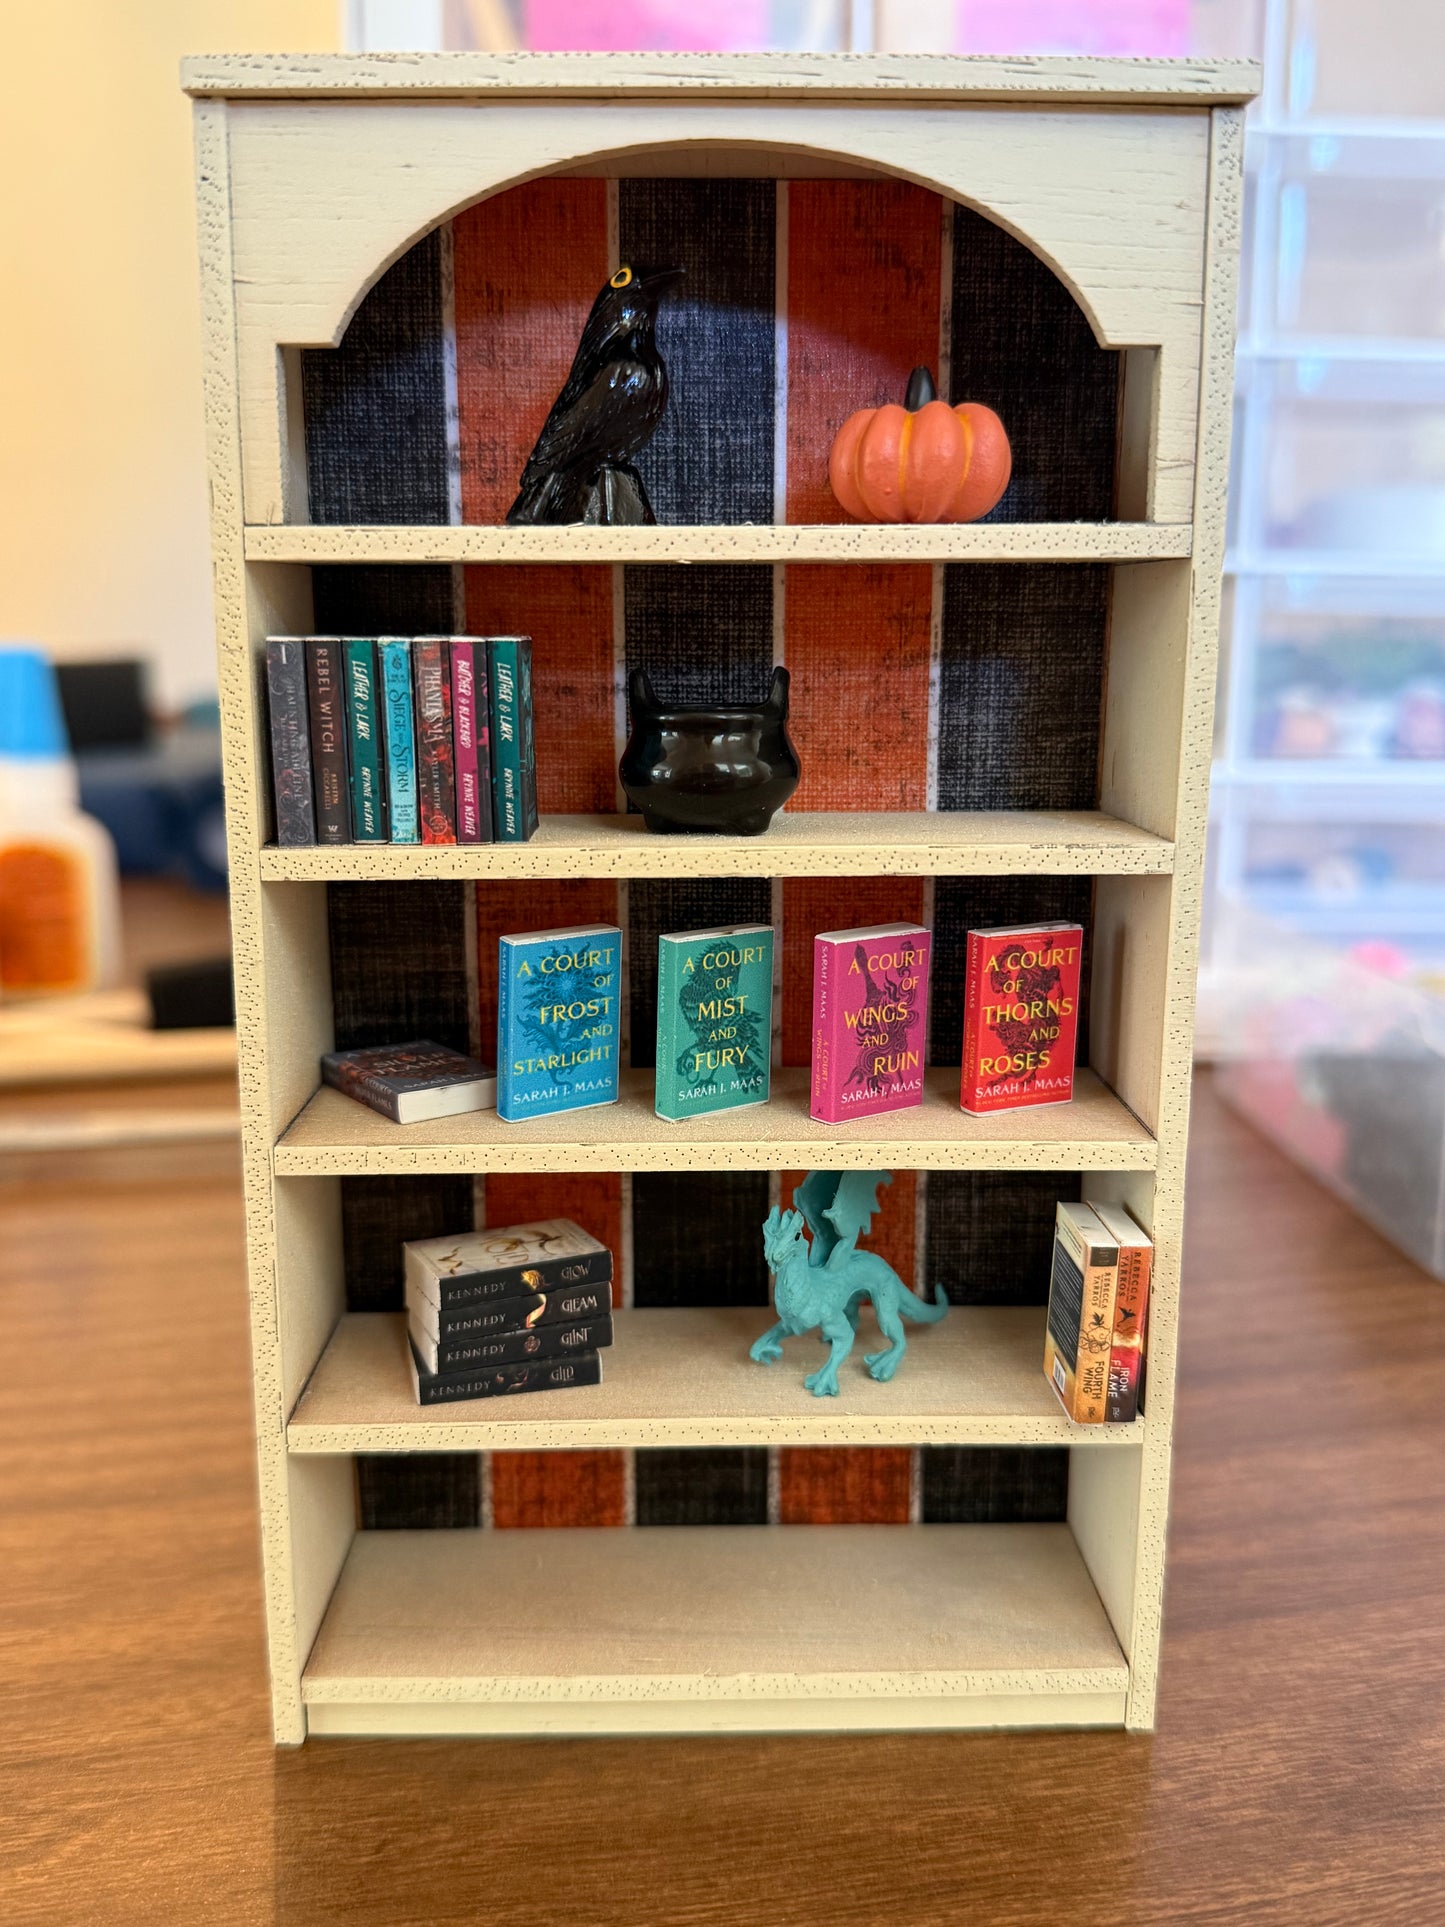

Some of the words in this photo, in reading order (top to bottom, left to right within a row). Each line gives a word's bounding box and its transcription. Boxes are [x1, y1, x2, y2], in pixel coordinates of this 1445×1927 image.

[316, 648, 329, 694] REBEL
[351, 661, 370, 702] LEATHER
[457, 660, 472, 695] BUTCHER
[497, 662, 513, 702] LEATHER
[356, 702, 367, 711] &
[389, 689, 409, 732] SIEGE
[422, 667, 445, 744] PHANTASMA
[319, 701, 334, 753] WITCH
[356, 713, 370, 740] LARK
[458, 706, 472, 749] BLACKBIRD
[499, 715, 513, 742] LARK
[361, 767, 373, 797] BRYNNE
[391, 744, 410, 793] STORM
[503, 768, 513, 798] BRYNNE
[433, 782, 441, 809] SMITH
[463, 773, 474, 802] BRYNNE
[364, 801, 374, 833] WEAVER
[464, 806, 476, 836] WEAVER
[505, 802, 515, 834] WEAVER
[516, 960, 533, 978] A
[540, 948, 614, 974] COURT
[682, 956, 695, 974] A
[702, 946, 767, 970] COURT
[820, 946, 829, 979] SARAH
[848, 957, 860, 976] A
[867, 948, 926, 972] COURT
[970, 935, 978, 968] SARAH
[984, 954, 1000, 973] A
[1006, 947, 1078, 971] COURT
[593, 975, 614, 988] OF
[714, 976, 734, 991] OF
[901, 975, 919, 991] OF
[1003, 979, 1023, 994] OF
[540, 997, 613, 1025] FROST
[697, 995, 749, 1022] MIST
[819, 990, 828, 1019] MAAS
[844, 1001, 908, 1030] WINGS
[982, 997, 1073, 1025] THORNS
[580, 1025, 613, 1040] AND
[708, 1026, 737, 1043] AND
[861, 1033, 889, 1049] AND
[1028, 1026, 1060, 1042] AND
[513, 1045, 613, 1076] STARLIGHT
[694, 1044, 750, 1073] FURY
[873, 1050, 919, 1076] RUIN
[979, 1050, 1051, 1077] ROSES
[513, 1086, 559, 1105] SARAH
[575, 1076, 612, 1093] MAAS
[678, 1084, 717, 1102] SARAH
[730, 1075, 763, 1091] MAAS
[840, 1087, 878, 1104] SARAH
[890, 1079, 921, 1095] MAAS
[975, 1081, 1019, 1099] SARAH
[1034, 1075, 1071, 1090] MAAS
[448, 1282, 507, 1301] KENNEDY
[561, 1260, 592, 1280] GLOW
[1101, 1272, 1112, 1309] REBECCA
[1119, 1255, 1129, 1298] YARROS
[1130, 1251, 1142, 1301] REBECCA
[1091, 1276, 1101, 1307] YARROS
[447, 1314, 506, 1333] KENNEDY
[561, 1295, 598, 1313] GLEAM
[447, 1344, 506, 1362] KENNEDY
[561, 1327, 592, 1346] GLINT
[430, 1381, 491, 1398] KENNEDY
[551, 1366, 575, 1382] GILD
[1082, 1368, 1094, 1394] WING
[1092, 1361, 1105, 1400] FOURTH
[1107, 1359, 1121, 1398] FLAME
[1119, 1367, 1130, 1393] IRON
